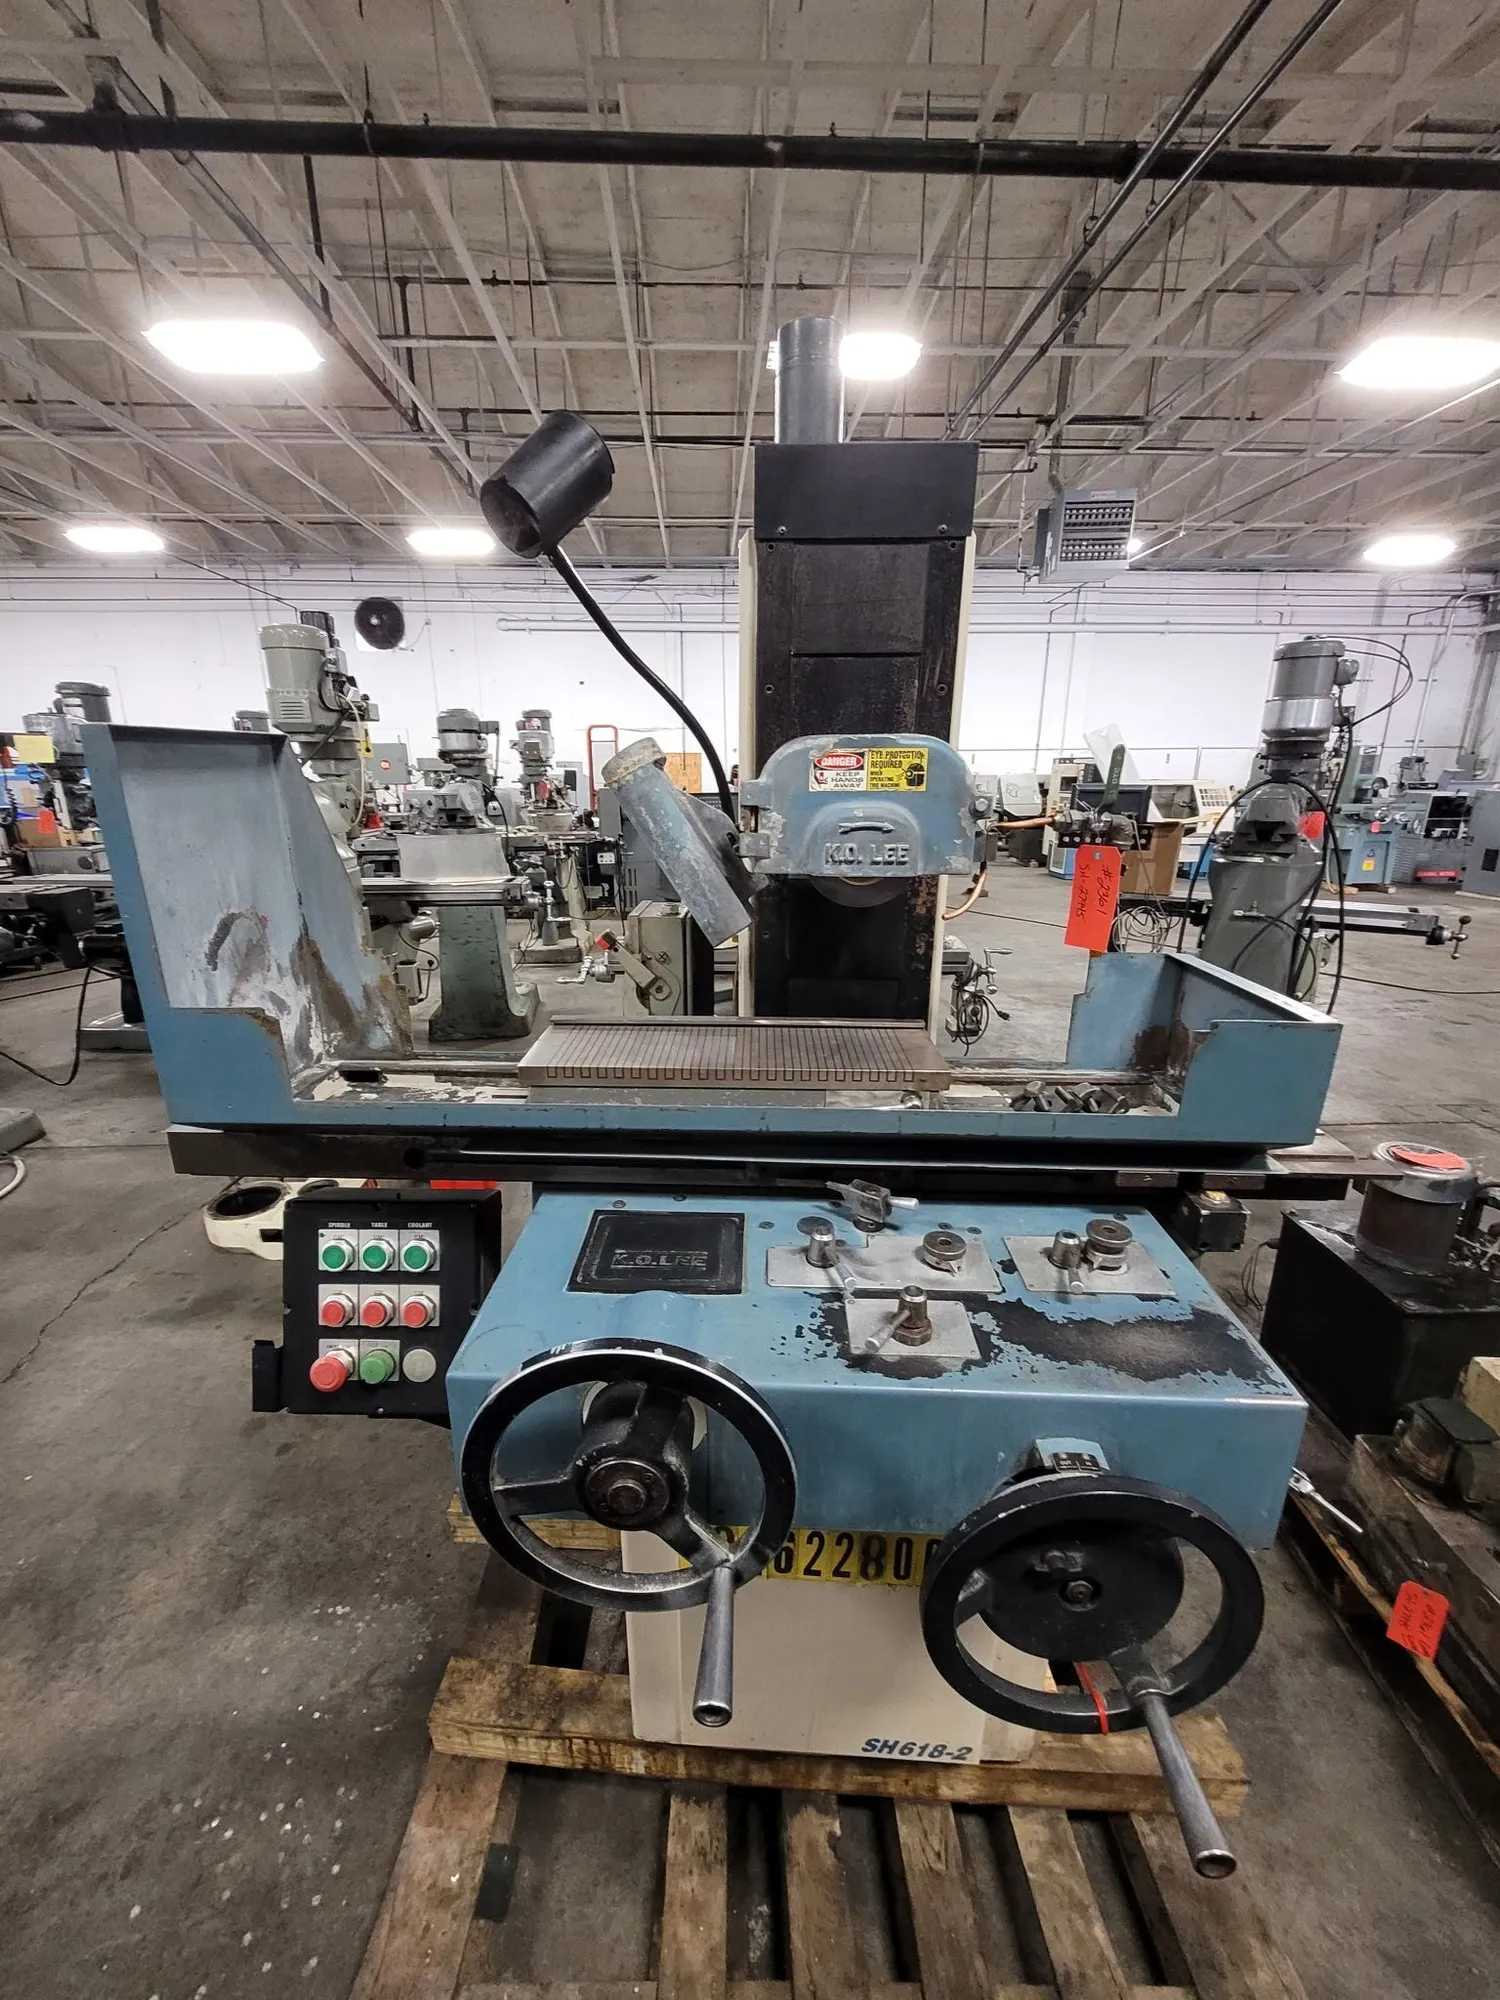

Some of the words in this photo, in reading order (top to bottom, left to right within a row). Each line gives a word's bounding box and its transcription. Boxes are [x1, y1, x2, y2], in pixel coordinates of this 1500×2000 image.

[870, 750, 883, 759] EYE
[820, 756, 858, 766] DANGER
[870, 760, 903, 769] REQUIRED
[869, 843, 910, 866] LEE
[861, 1737, 973, 1760] SH618-2
